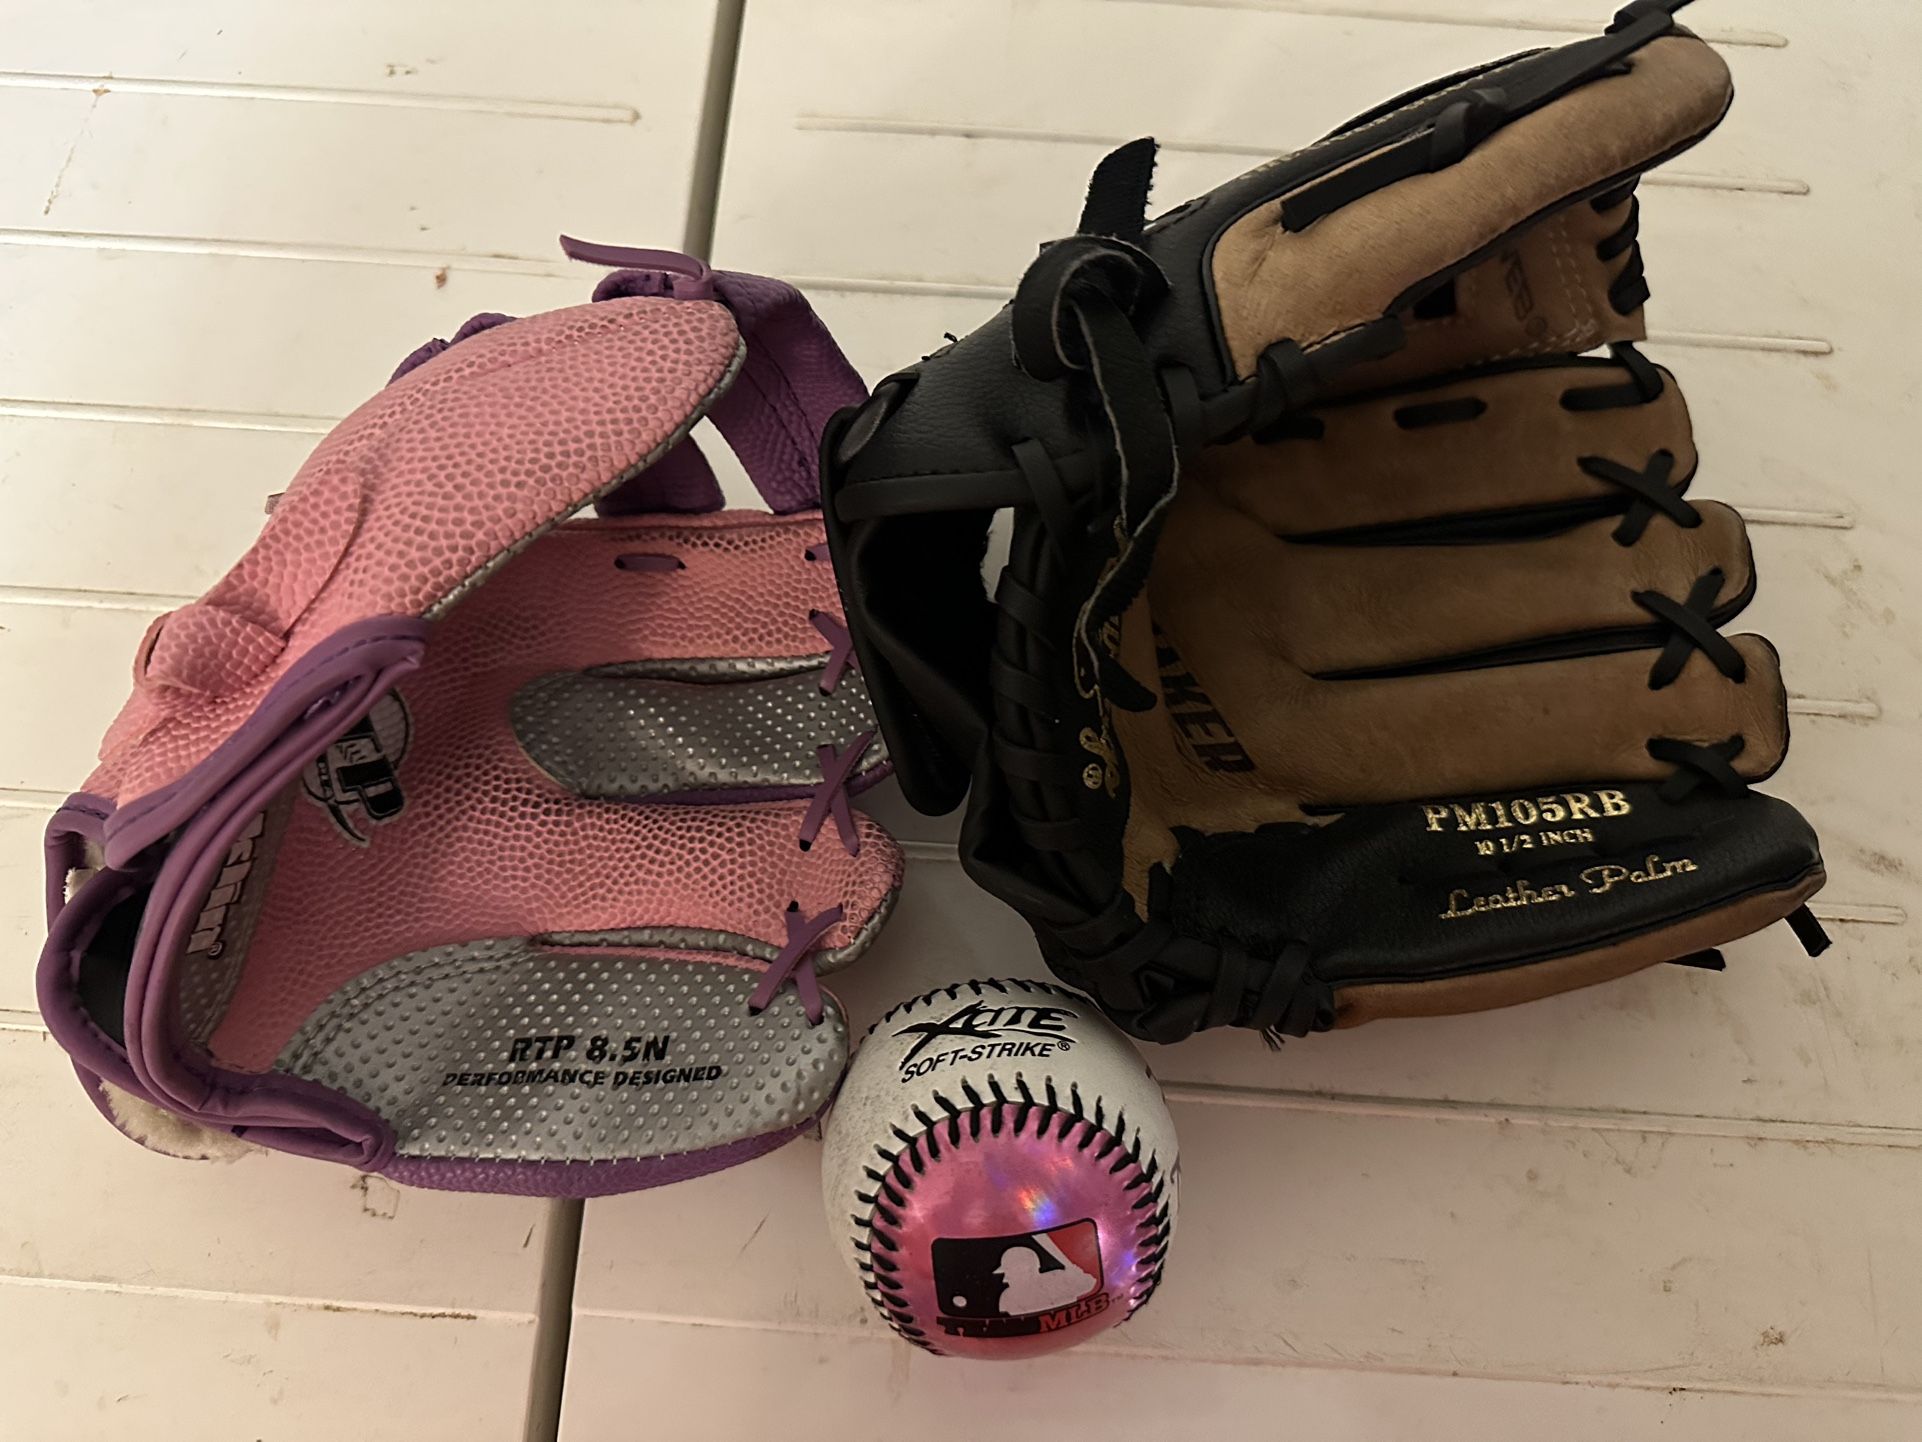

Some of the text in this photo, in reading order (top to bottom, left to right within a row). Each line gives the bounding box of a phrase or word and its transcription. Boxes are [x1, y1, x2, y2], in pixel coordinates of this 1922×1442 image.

[1421, 789, 1632, 832] PM105RB
[1474, 828, 1595, 856] 10 1/2 INCH
[1438, 855, 1699, 920] Leather Palm
[508, 1034, 671, 1063] RTP 8.5N
[442, 1065, 723, 1087] PERFORMANCE DESIGNED
